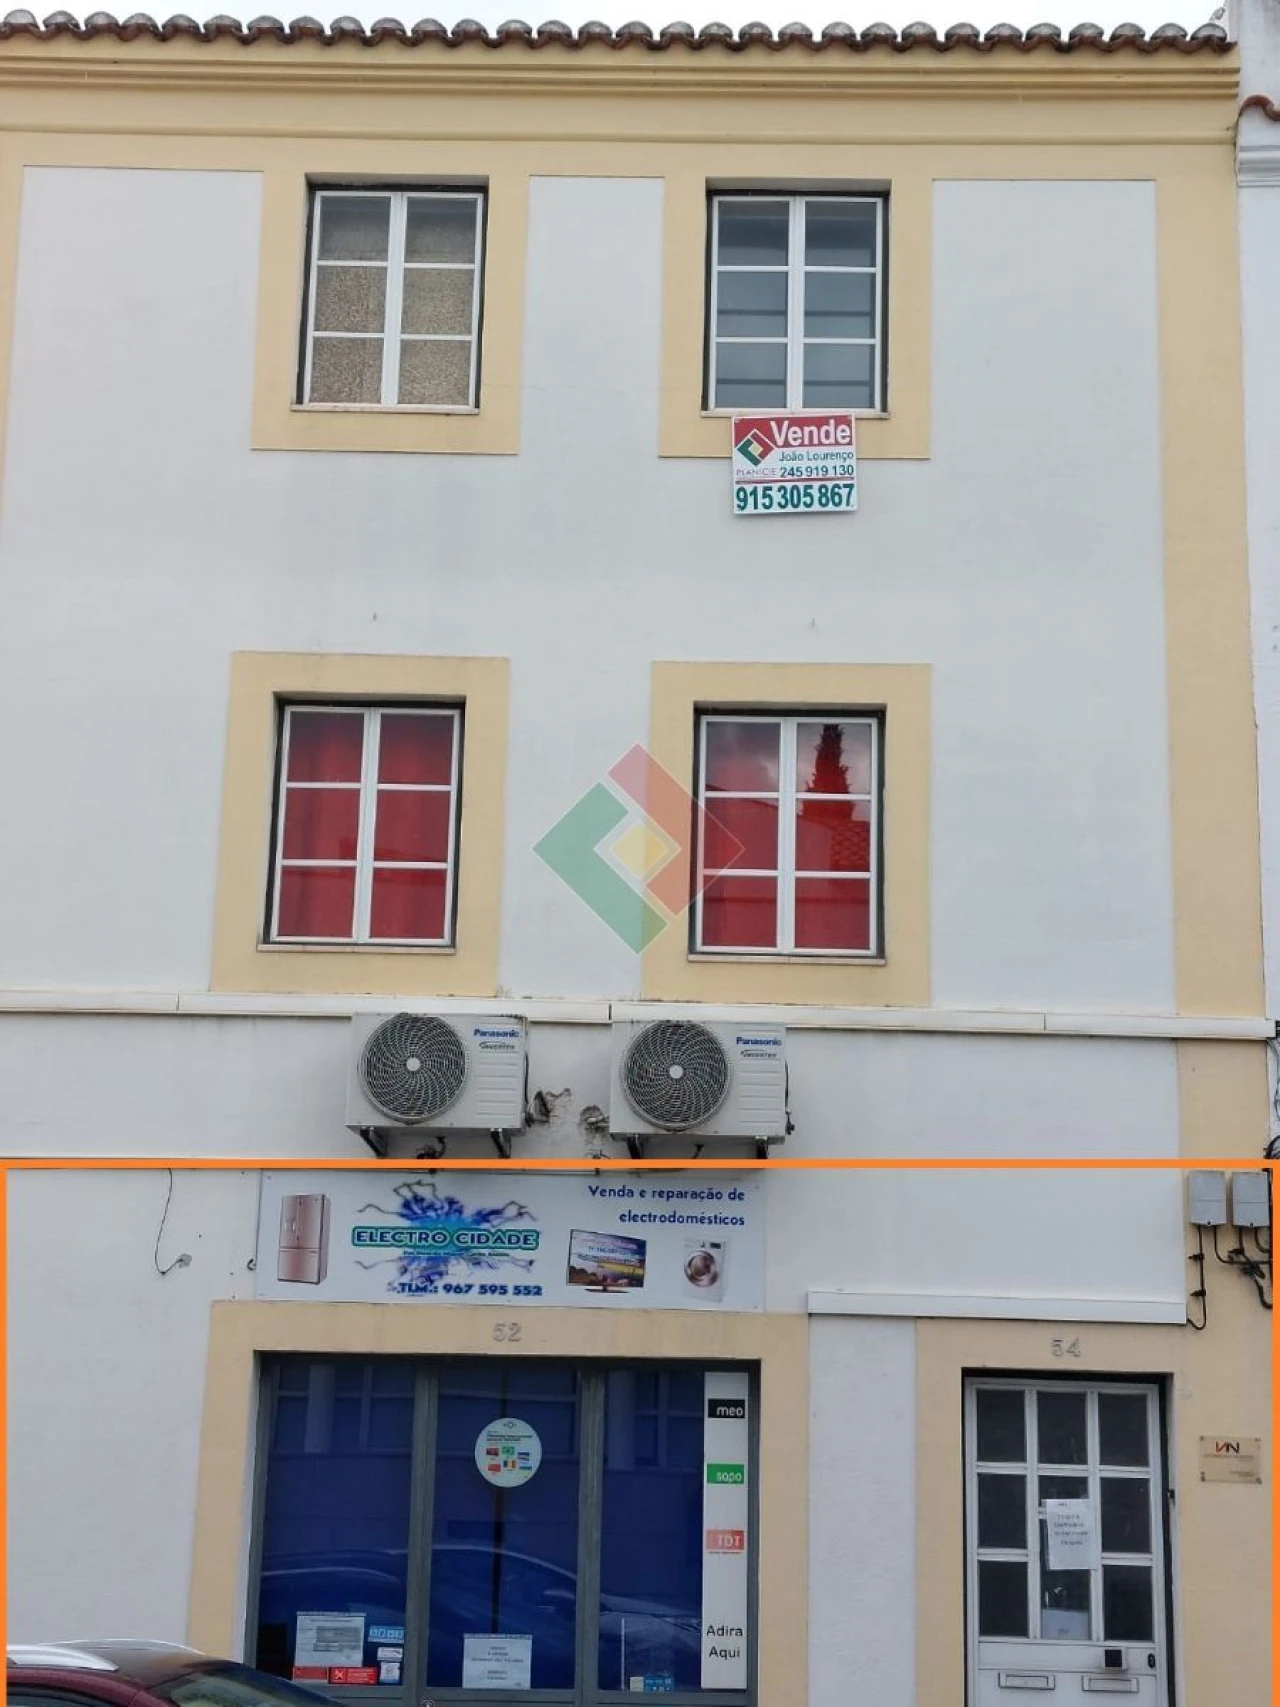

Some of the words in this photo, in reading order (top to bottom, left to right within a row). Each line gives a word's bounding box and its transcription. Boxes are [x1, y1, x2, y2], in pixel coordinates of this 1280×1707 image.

[770, 419, 851, 446] Vende
[779, 450, 804, 462] João
[807, 451, 854, 463] Lourenço
[780, 466, 803, 478] 245
[805, 465, 829, 477] 919
[832, 464, 854, 476] 130
[736, 485, 774, 511] 915
[777, 484, 815, 509] 305
[817, 483, 855, 508] 867
[588, 1185, 634, 1199] Venda
[639, 1189, 647, 1199] e
[652, 1187, 723, 1202] reparação
[727, 1188, 745, 1202] de
[619, 1209, 745, 1226] electrodomésticos
[356, 1230, 448, 1244] ELECTRO
[455, 1231, 535, 1246] CIDADE
[443, 1283, 473, 1295] 967
[478, 1284, 508, 1296] 595
[512, 1285, 542, 1297] 552
[493, 1321, 522, 1342] 52
[1050, 1336, 1082, 1358] 54
[716, 1405, 744, 1417] meo
[717, 1535, 742, 1548] TDT
[706, 1624, 743, 1637] Adira
[709, 1645, 741, 1661] Aqui
